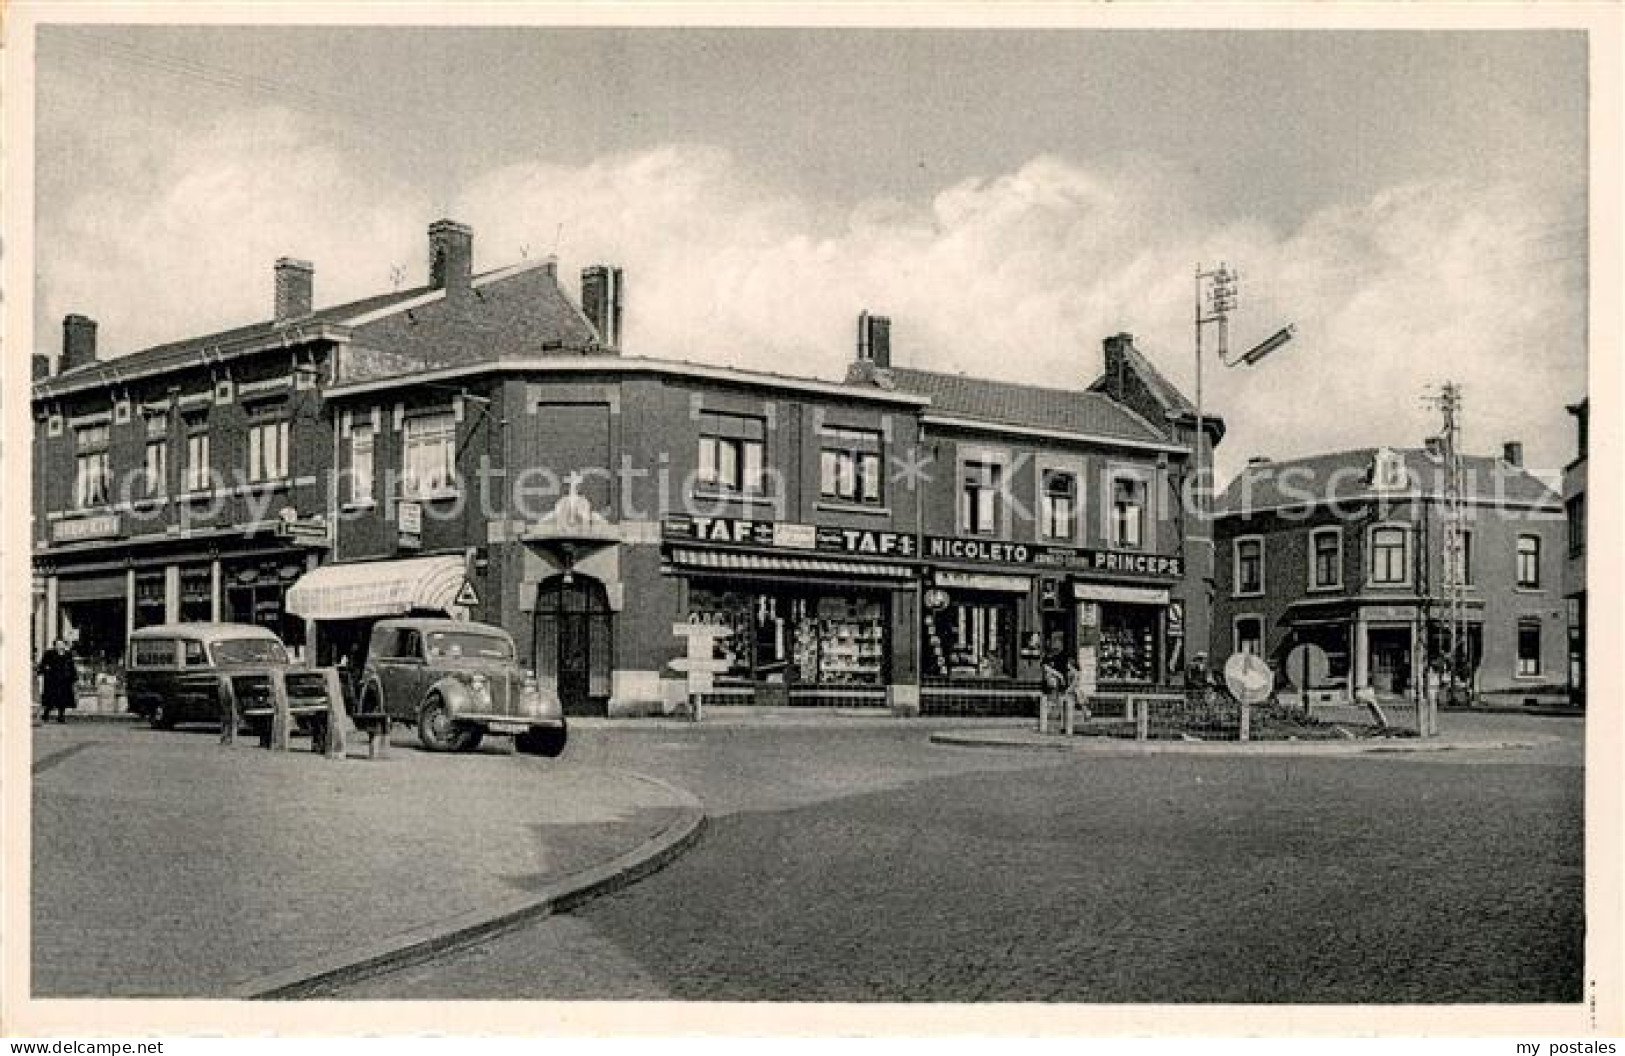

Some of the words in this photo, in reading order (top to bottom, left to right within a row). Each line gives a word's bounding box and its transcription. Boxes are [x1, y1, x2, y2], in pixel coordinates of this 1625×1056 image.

[693, 517, 753, 541] TAF
[842, 531, 897, 553] TAF
[931, 538, 1028, 562] NICOLETO
[1095, 552, 1178, 576] PRINCEPS
